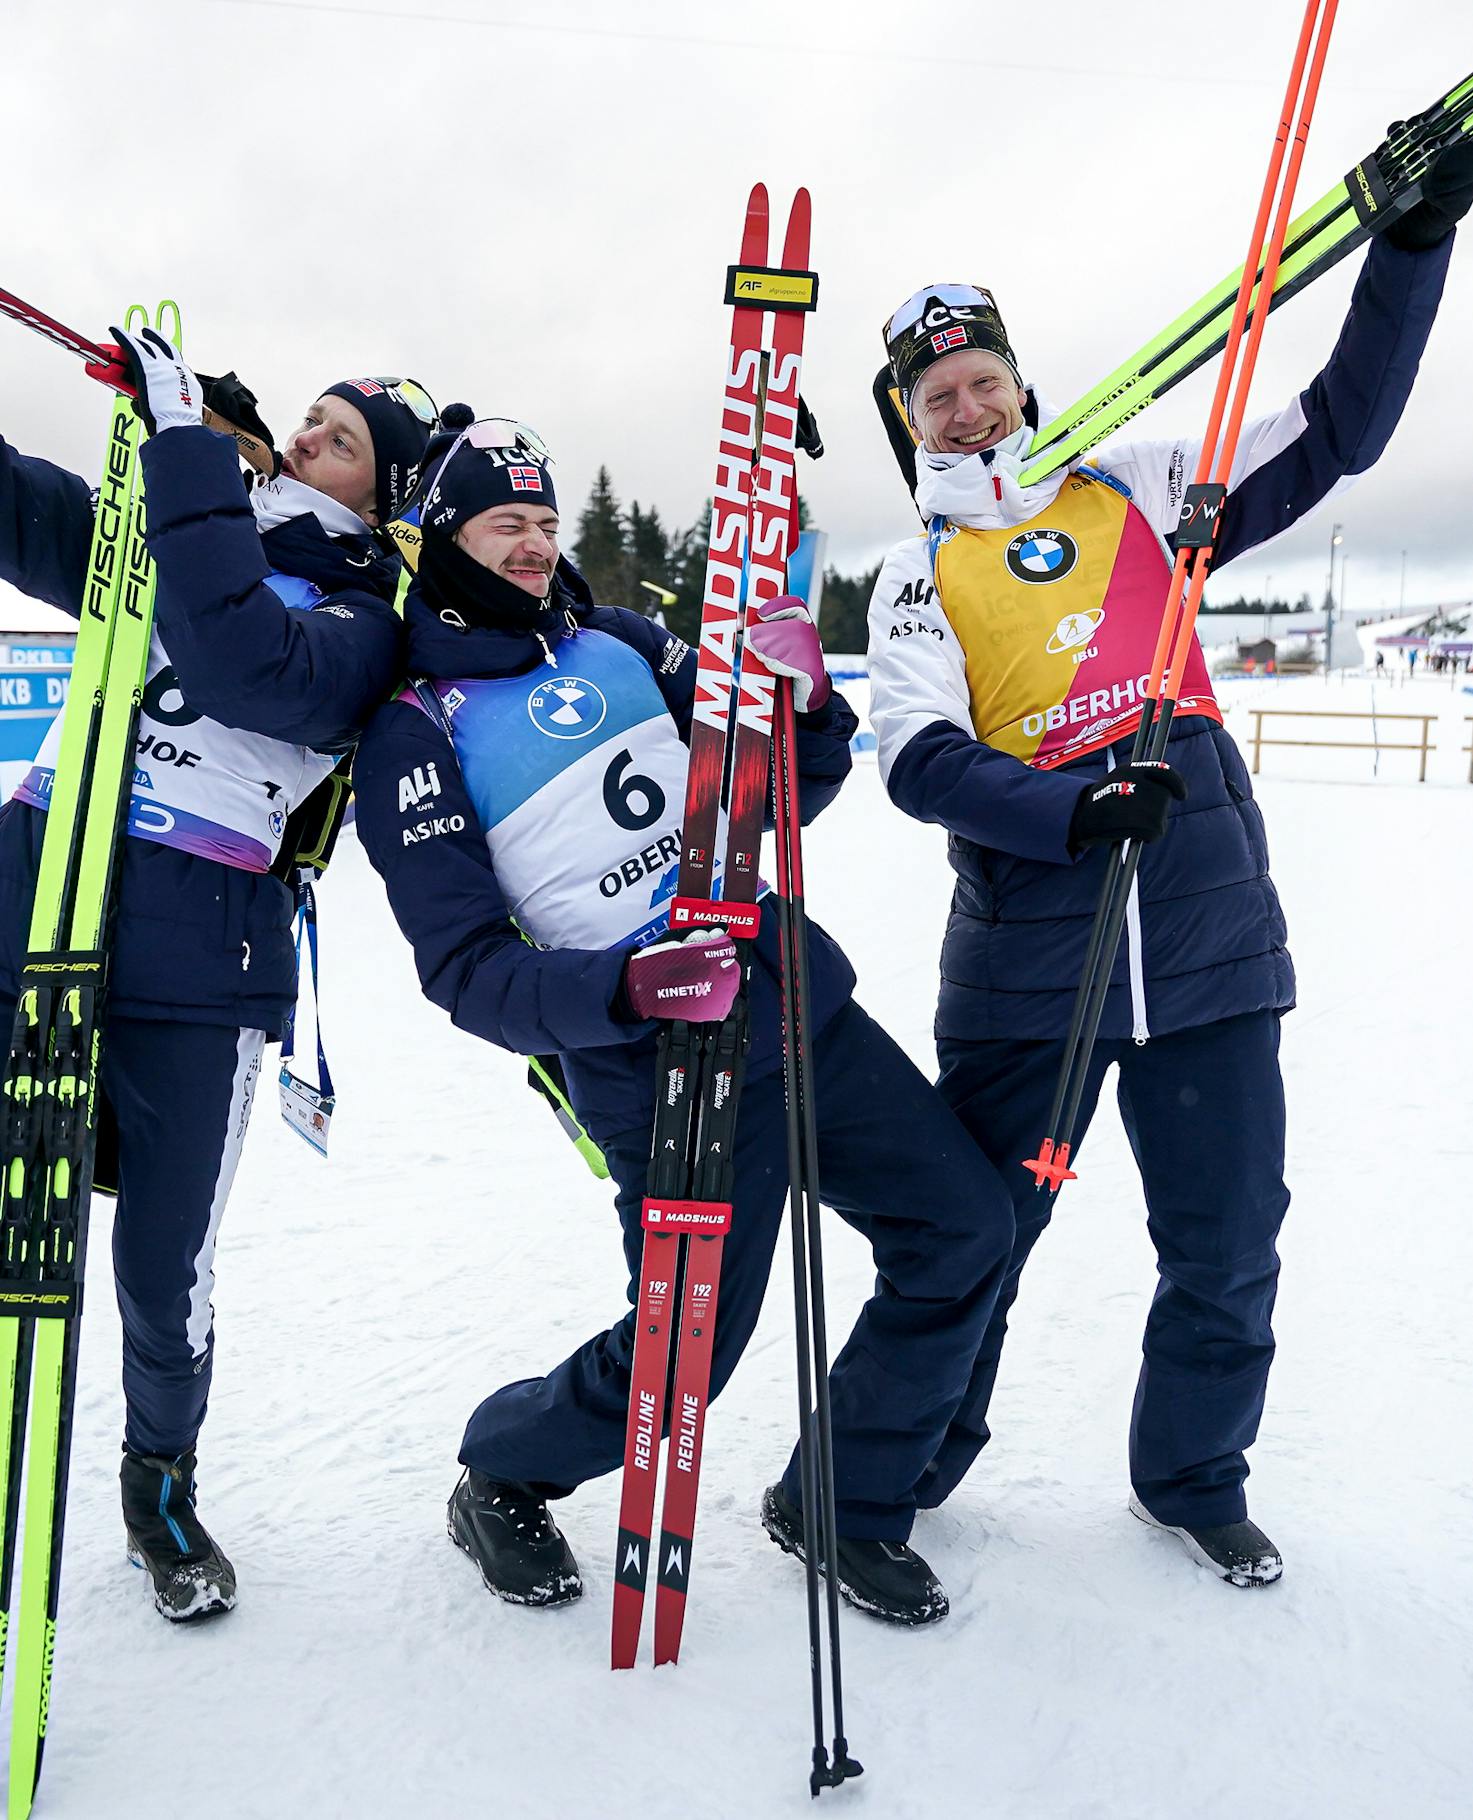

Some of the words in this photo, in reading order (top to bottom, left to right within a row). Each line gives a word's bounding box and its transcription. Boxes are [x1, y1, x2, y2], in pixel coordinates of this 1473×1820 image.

[739, 280, 762, 291] AF
[390, 463, 399, 508] CRAFT
[88, 412, 135, 623] FISCHER
[693, 345, 761, 734] MADSHUS
[737, 347, 802, 737] MDSHUS
[1009, 531, 1060, 552] BMW
[125, 494, 151, 621] FISC
[1072, 646, 1099, 665] IBU
[0, 678, 31, 705] KB
[532, 679, 578, 708] BMW
[602, 748, 666, 832] 6
[598, 828, 684, 899] OBER
[693, 911, 755, 926] MADSHUS
[23, 960, 101, 974] FISCHER
[665, 1213, 726, 1225] MADSHUS
[648, 1280, 668, 1294] 192
[692, 1283, 712, 1297] 192
[634, 1389, 656, 1471] REDLINE
[676, 1392, 699, 1473] REDLINE
